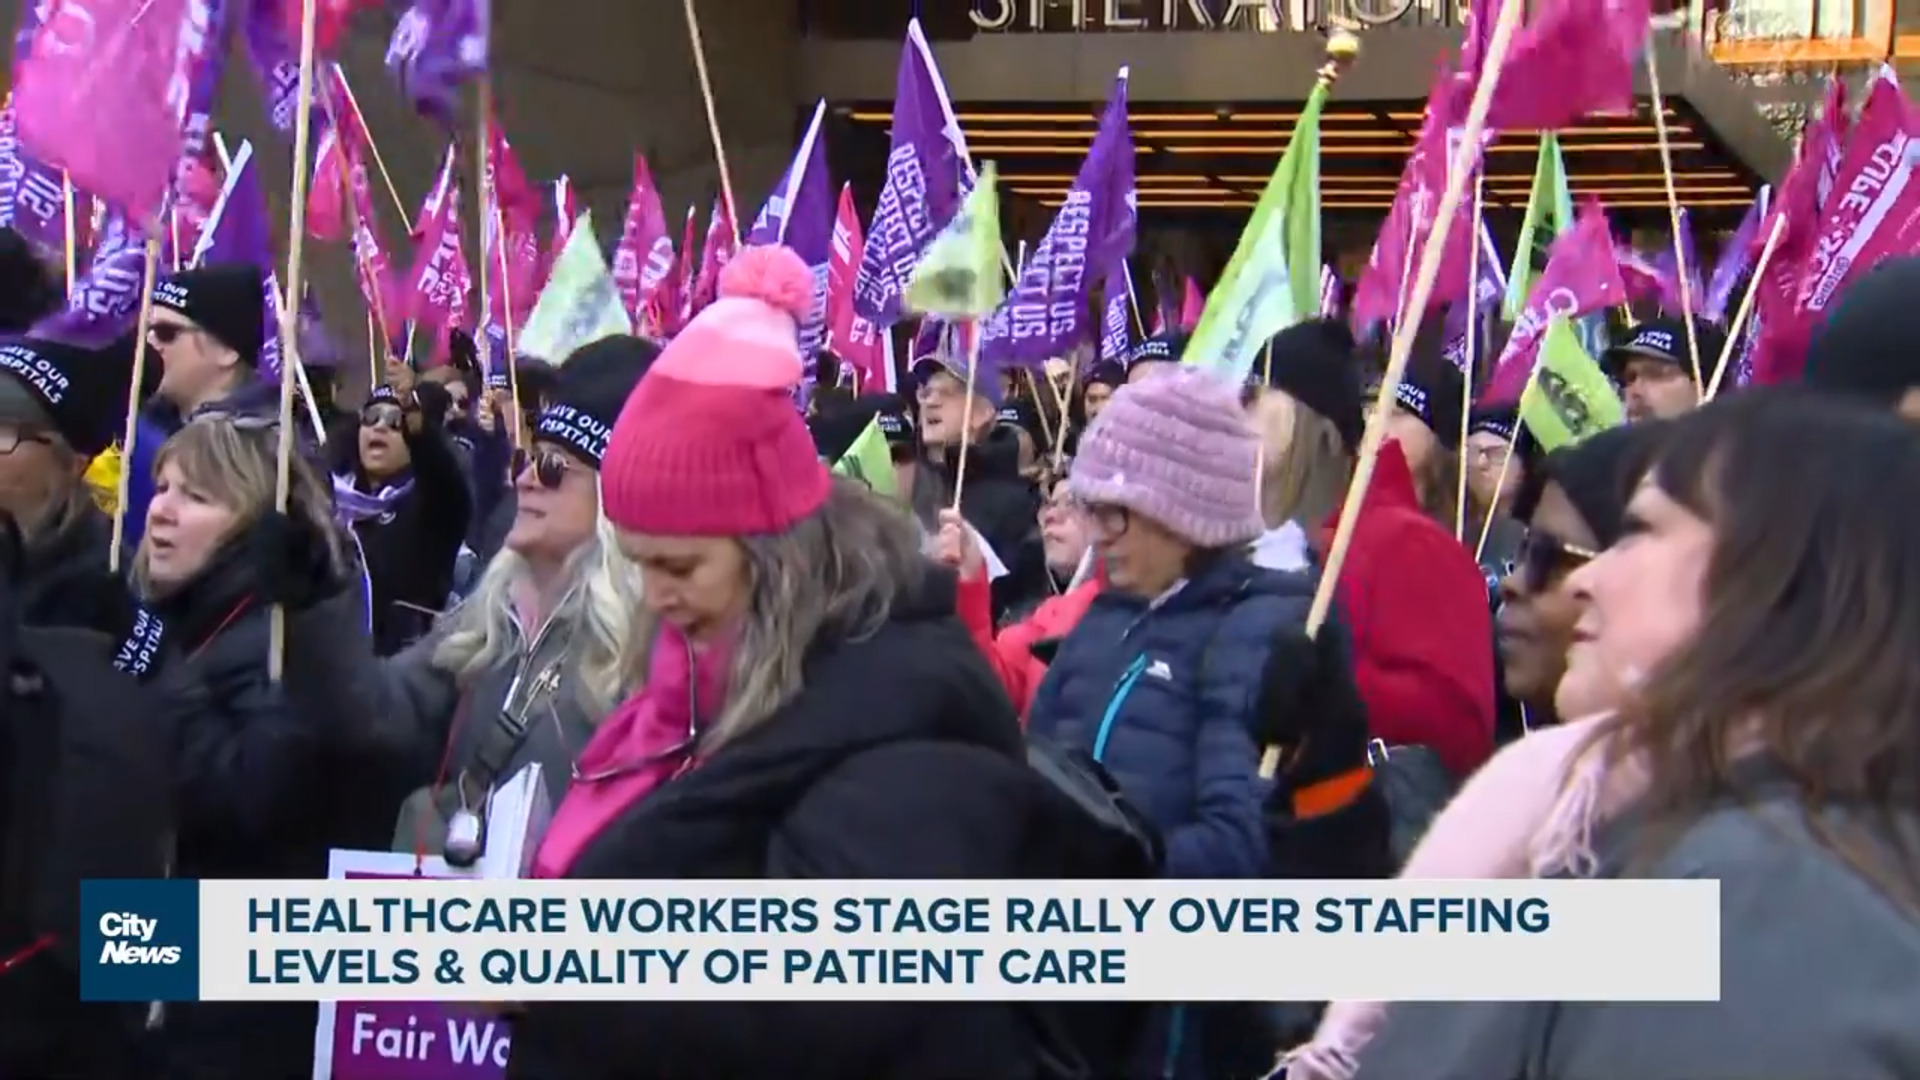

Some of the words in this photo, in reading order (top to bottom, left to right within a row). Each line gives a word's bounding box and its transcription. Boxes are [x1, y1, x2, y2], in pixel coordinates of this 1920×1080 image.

[1011, 304, 1047, 344] US.
[1050, 301, 1076, 343] US.
[36, 359, 69, 389] OUR
[352, 1013, 436, 1060] Fair
